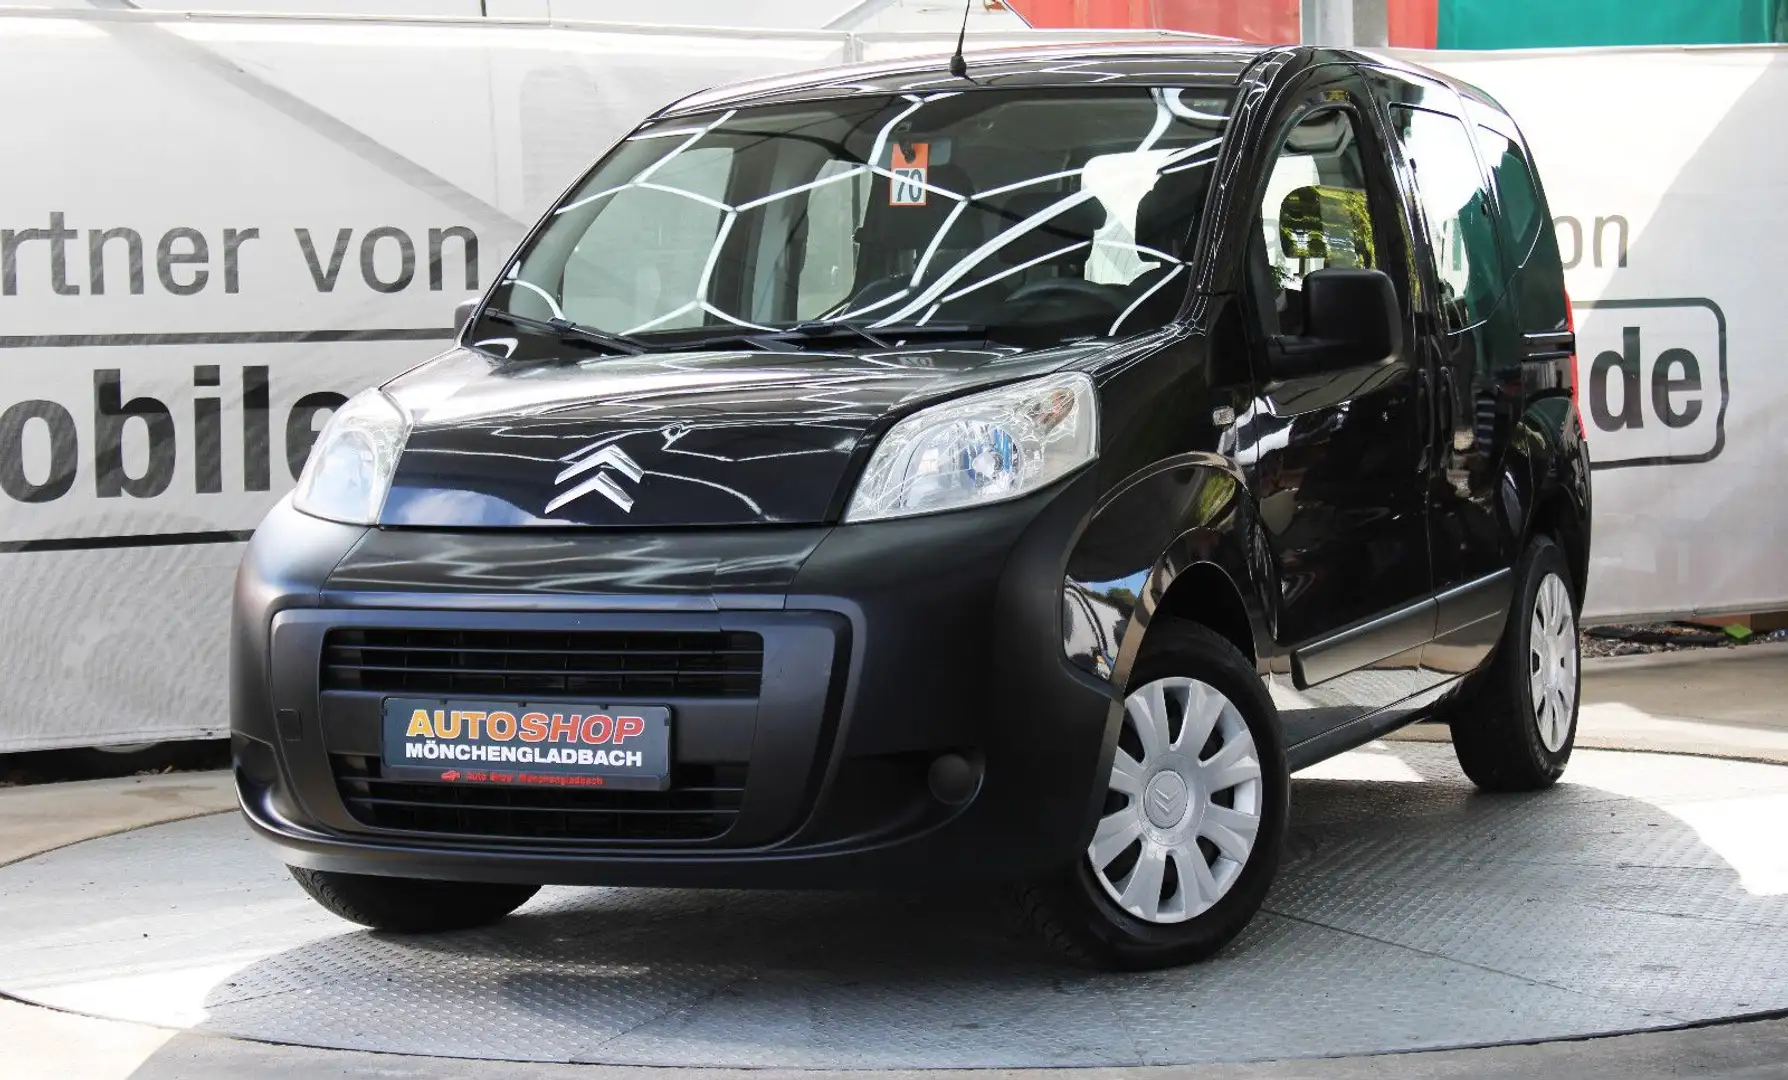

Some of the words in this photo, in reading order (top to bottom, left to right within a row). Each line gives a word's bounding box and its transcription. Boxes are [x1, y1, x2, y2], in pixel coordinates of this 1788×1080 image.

[895, 169, 922, 203] 70
[1, 211, 260, 296] rtner
[294, 226, 480, 292] von
[1589, 326, 1703, 432] de
[405, 709, 645, 745] AUTOSHOP
[405, 741, 642, 767] MÖNCHENGLADBACH
[465, 771, 487, 781] Auto
